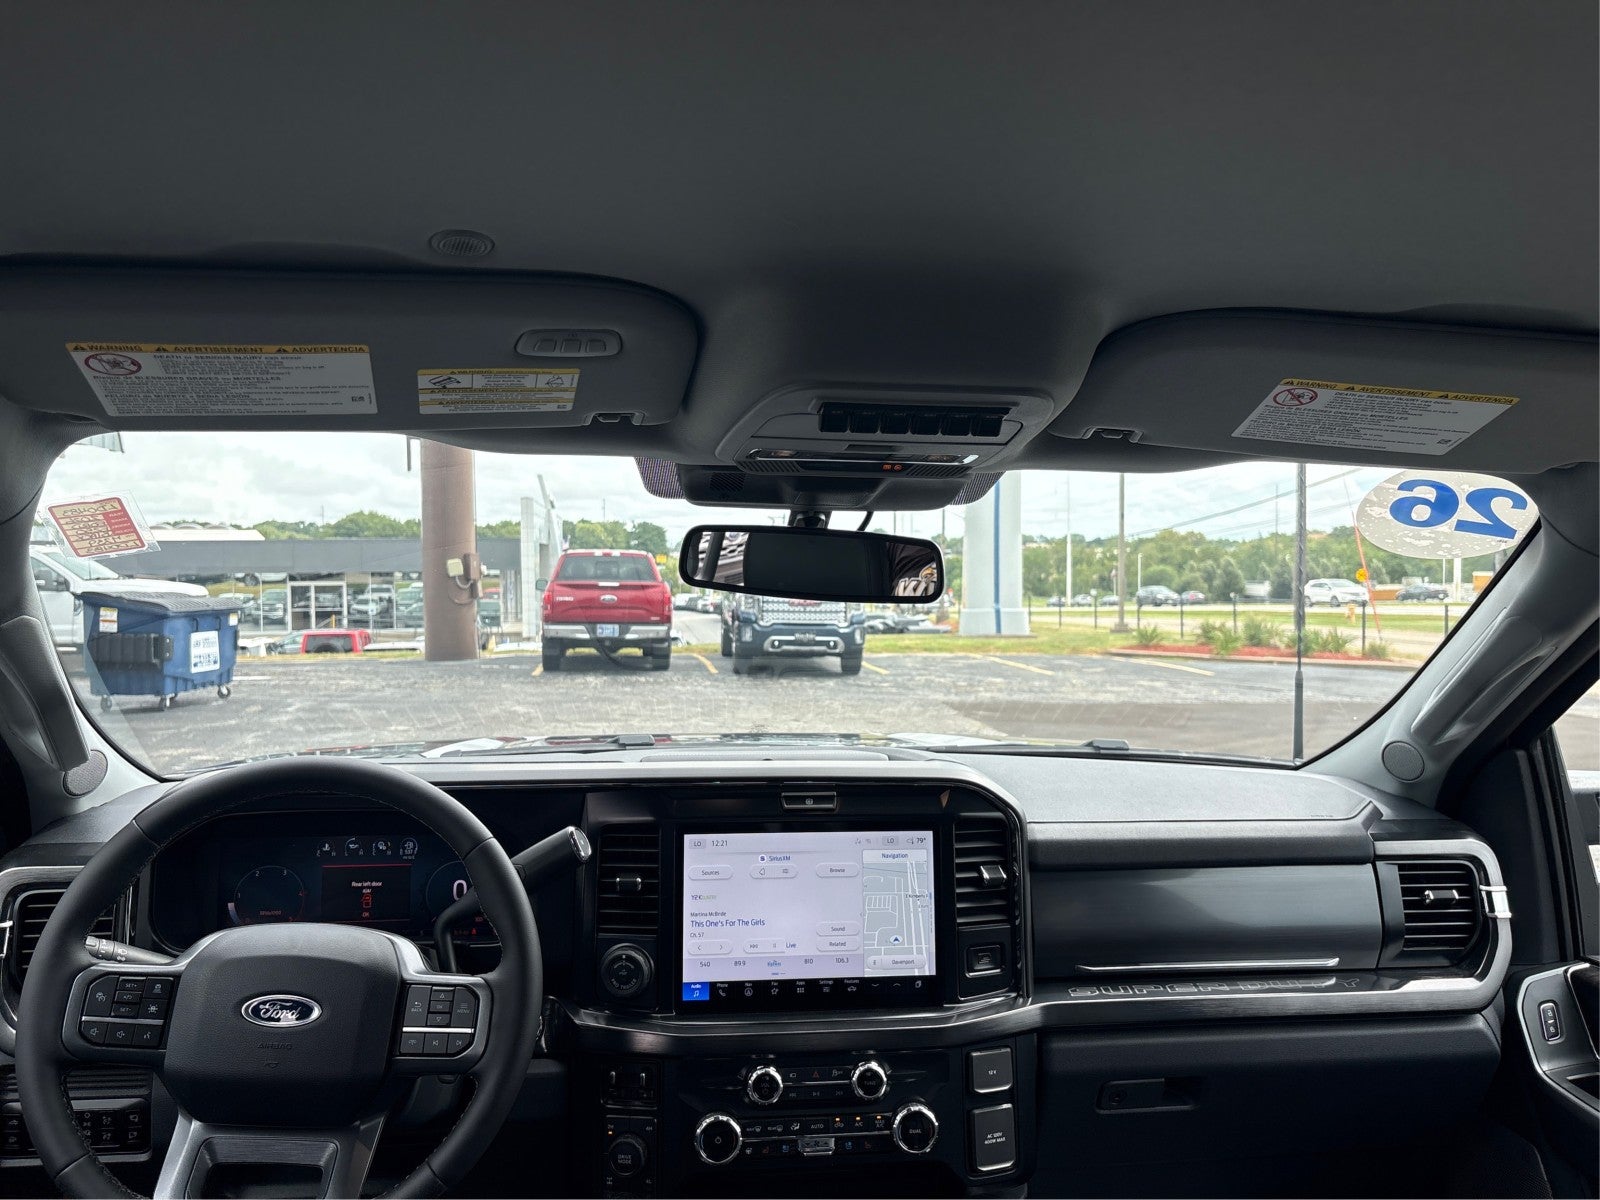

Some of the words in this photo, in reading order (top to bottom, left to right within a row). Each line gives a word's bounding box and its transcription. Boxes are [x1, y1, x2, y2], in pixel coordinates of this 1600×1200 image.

[87, 344, 143, 352] WARNING
[173, 345, 264, 354] AVERTISSEMENT
[291, 345, 366, 354] ADVERTENCIA
[1296, 380, 1338, 390] WARNING
[1359, 386, 1432, 398] AVERTISSEMENT
[1451, 394, 1514, 404] ADVERTENCIA
[916, 836, 926, 844] 79°
[690, 920, 705, 928] This
[705, 920, 724, 928] One's
[725, 920, 737, 928] For
[750, 918, 766, 926] Girls
[1068, 978, 1231, 998] SUPER
[1240, 977, 1360, 993] DUTY
[259, 1000, 302, 1020] Ford
